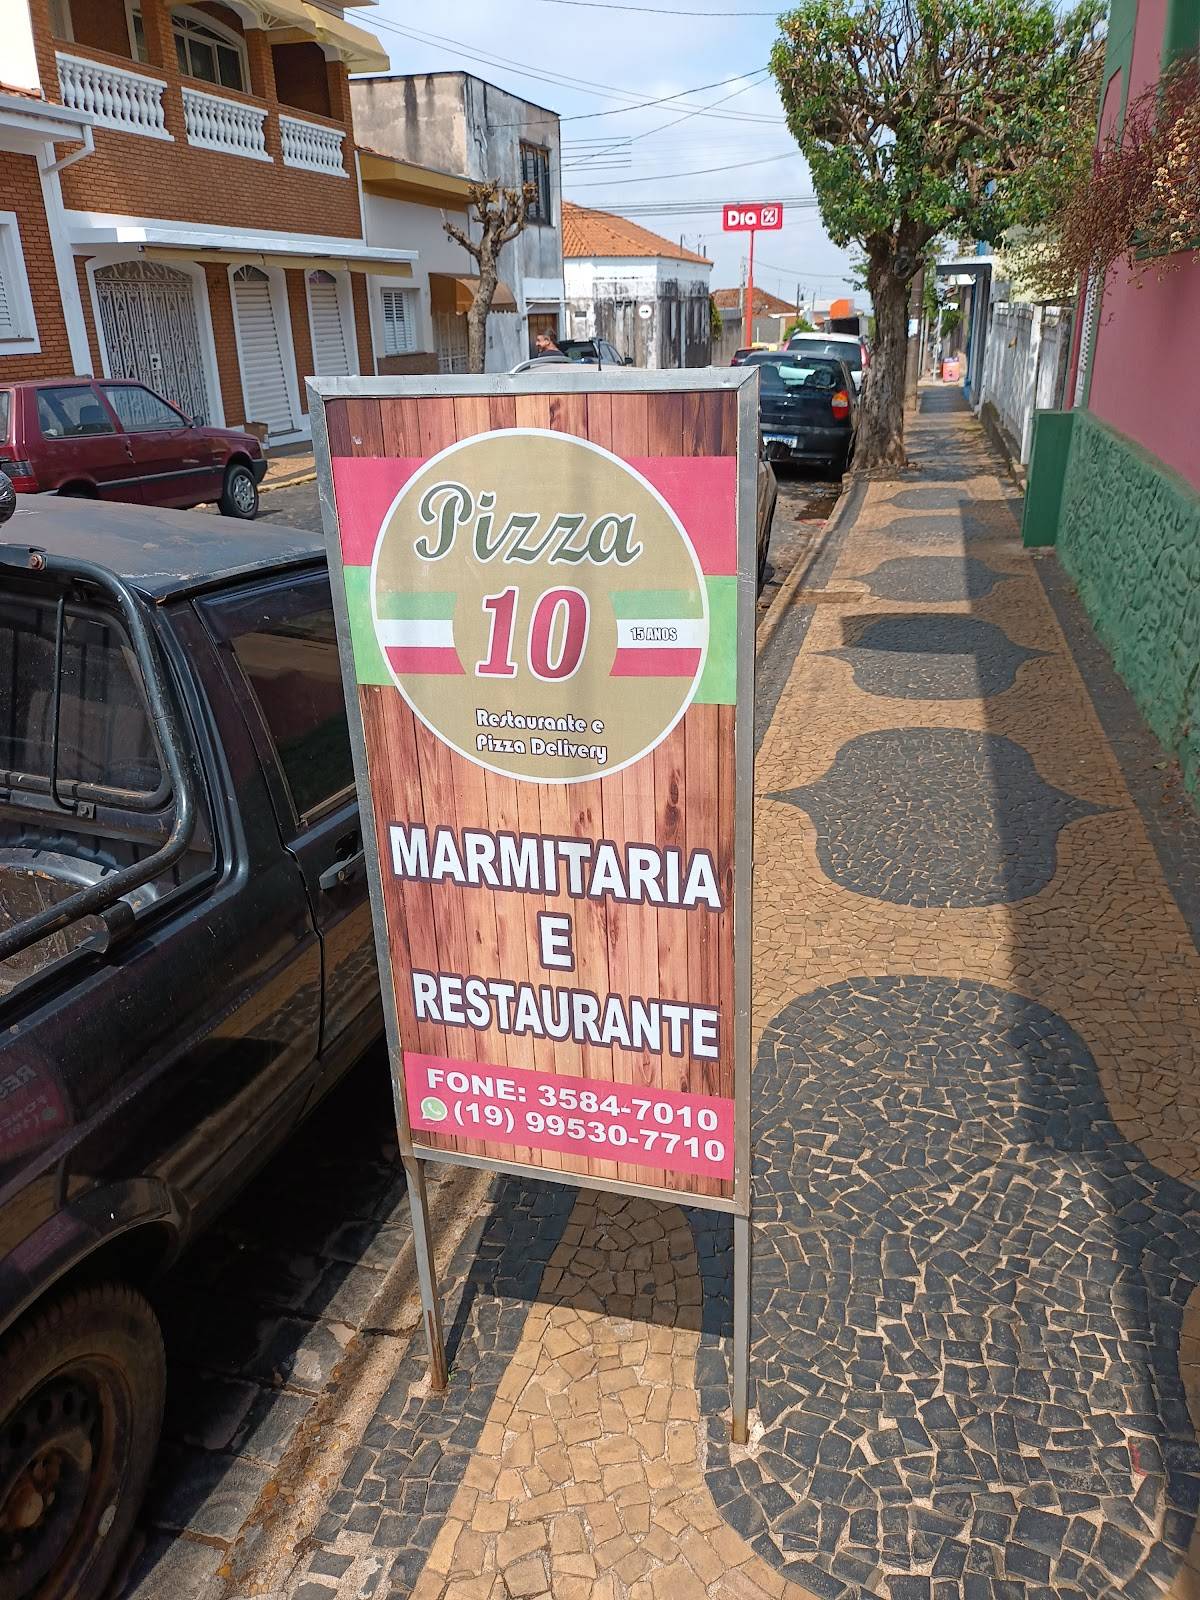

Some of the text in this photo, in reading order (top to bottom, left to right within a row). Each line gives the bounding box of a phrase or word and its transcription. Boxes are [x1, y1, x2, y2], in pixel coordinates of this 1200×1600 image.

[414, 480, 643, 566] Pizza
[475, 586, 591, 682] 10
[630, 627, 678, 641] 15 ANOS
[476, 708, 605, 734] Restaurante e
[476, 734, 608, 764] Pizza Delivery
[388, 824, 723, 910] MARMITARIA
[539, 914, 573, 969] E
[410, 970, 720, 1060] RESTAURANTE
[427, 1068, 718, 1132] FONE: 3584-7010
[454, 1103, 726, 1163] (19) 99530-7710
